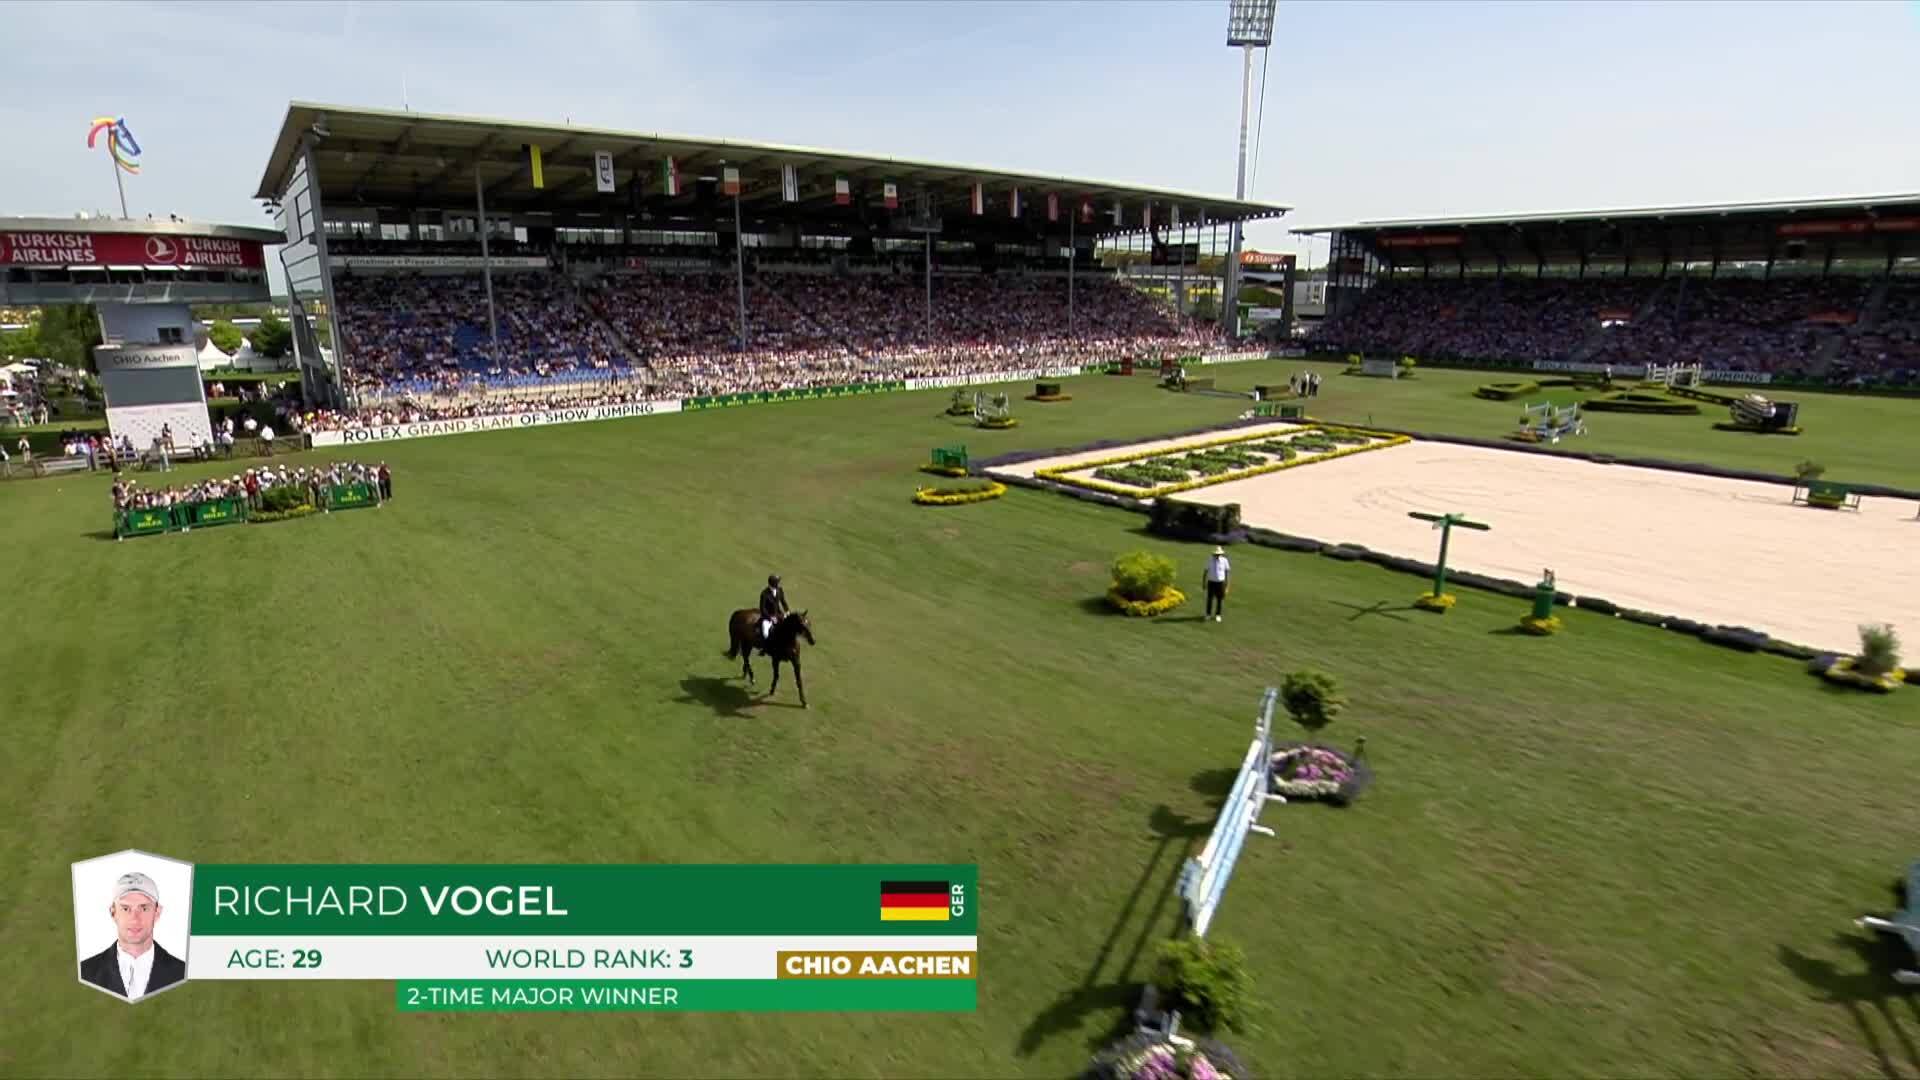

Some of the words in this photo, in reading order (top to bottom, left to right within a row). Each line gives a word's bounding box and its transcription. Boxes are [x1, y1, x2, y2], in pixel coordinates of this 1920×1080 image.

[8, 234, 91, 247] TURKISH
[183, 238, 240, 252] TURKISH
[12, 248, 96, 262] AIRLINES
[184, 251, 242, 265] AIRLINES
[112, 355, 142, 365] CHIO
[144, 353, 180, 363] Aachen
[343, 426, 402, 444] ROLEX
[408, 420, 466, 438] GRAND
[472, 416, 513, 431] SLAM
[520, 414, 542, 425] OF
[547, 409, 589, 422] SHOW
[595, 403, 654, 418] JUMPING
